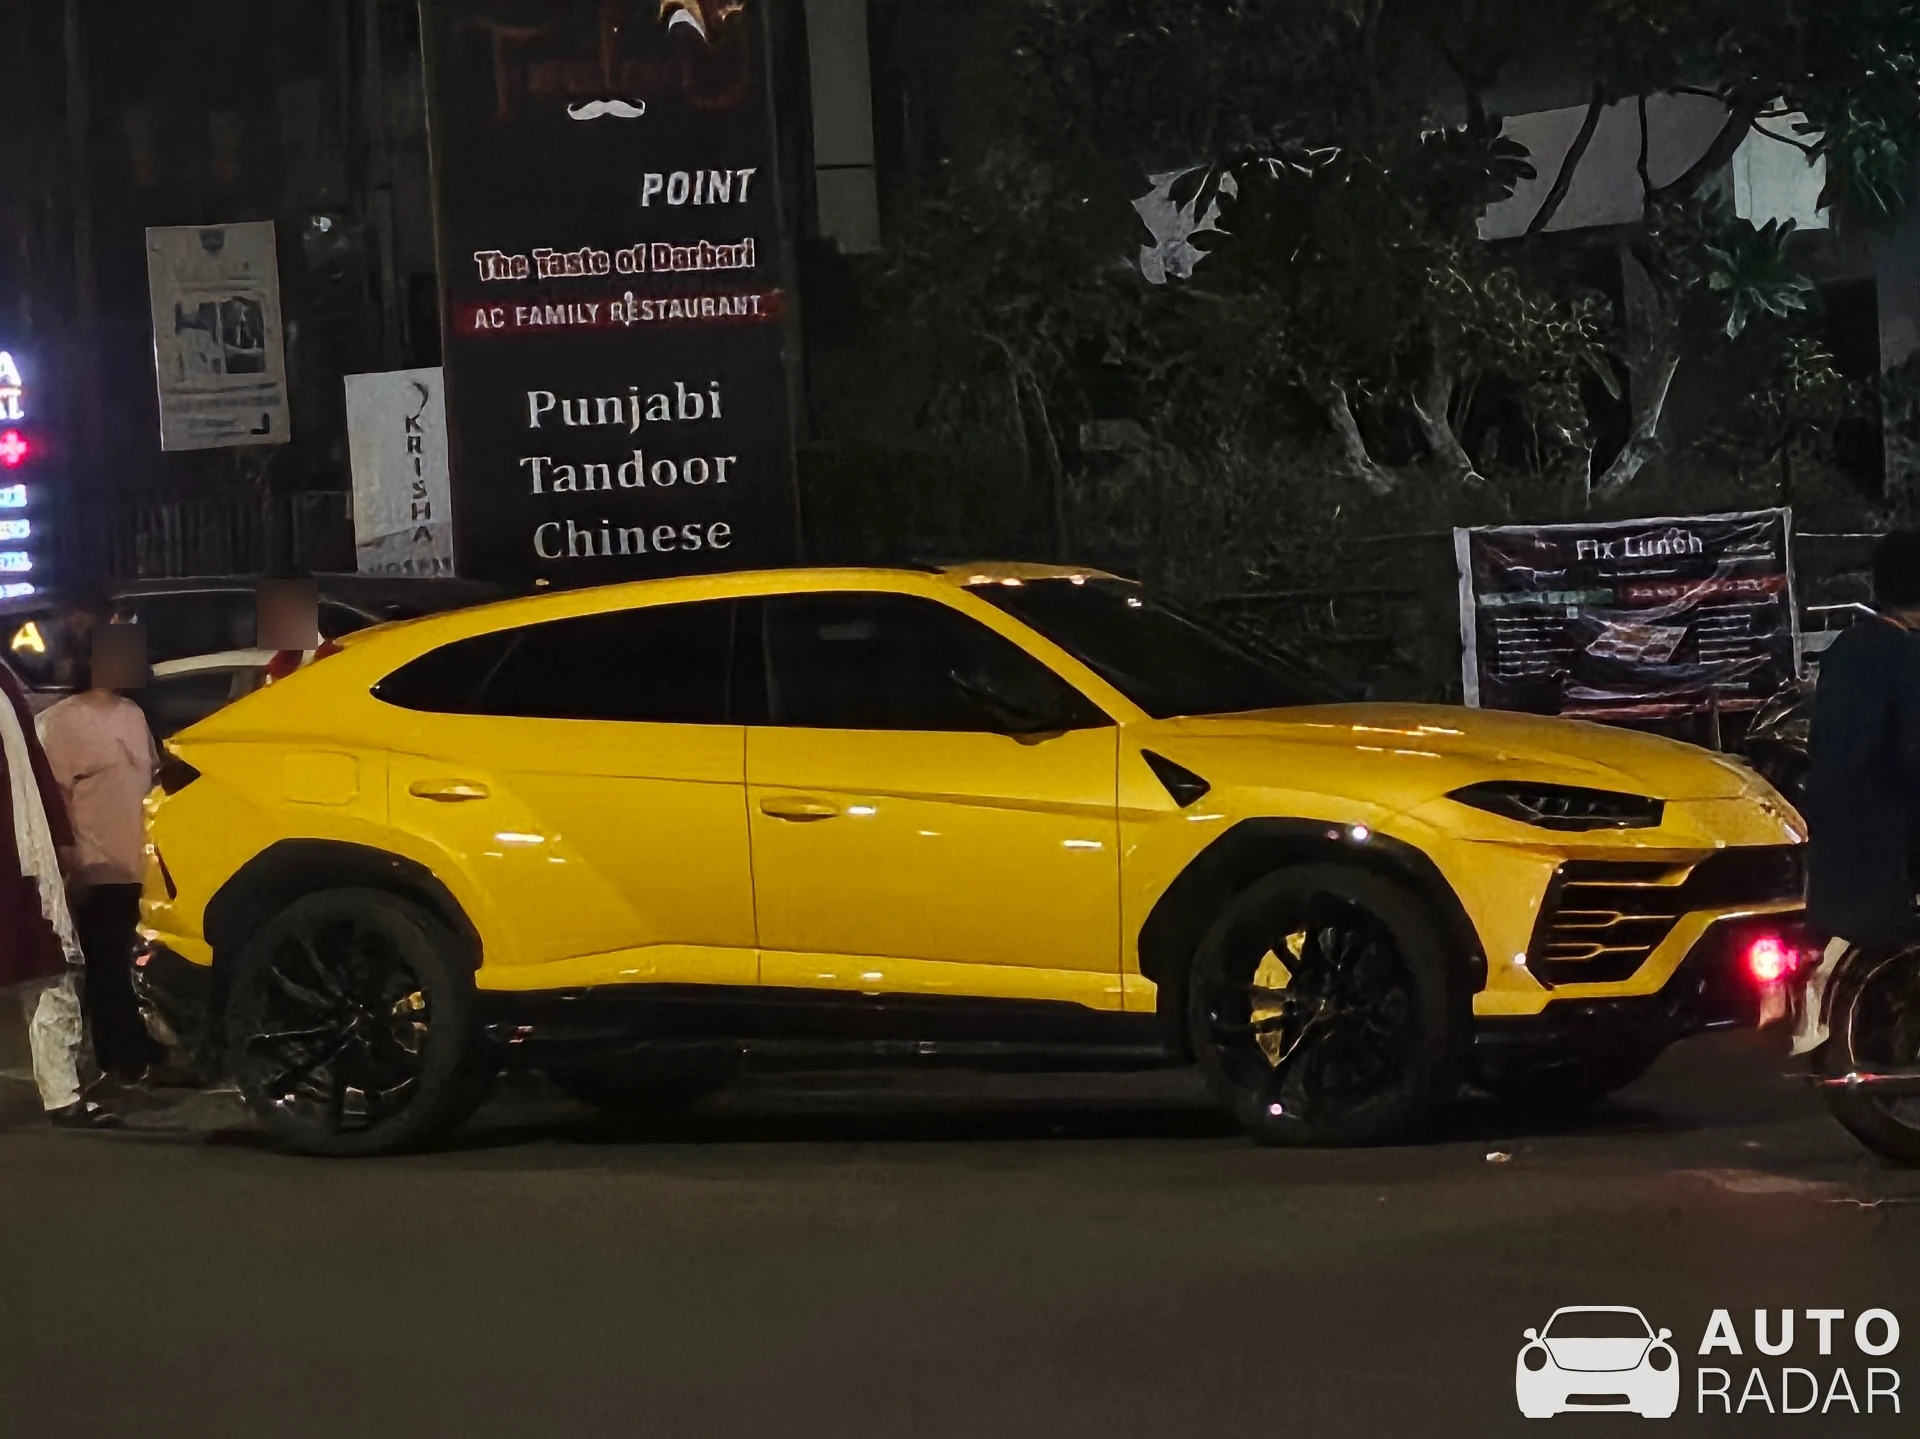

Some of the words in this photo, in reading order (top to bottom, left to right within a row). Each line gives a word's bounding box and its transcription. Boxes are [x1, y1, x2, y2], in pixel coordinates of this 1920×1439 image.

[641, 168, 757, 207] POINT
[474, 250, 530, 281] The
[532, 247, 610, 279] Taste
[615, 243, 646, 274] of
[475, 308, 505, 329] AC
[516, 303, 600, 327] FAMILY
[526, 380, 723, 434] Punjabi
[519, 449, 737, 494] Tandoor
[534, 519, 732, 559] Chinese
